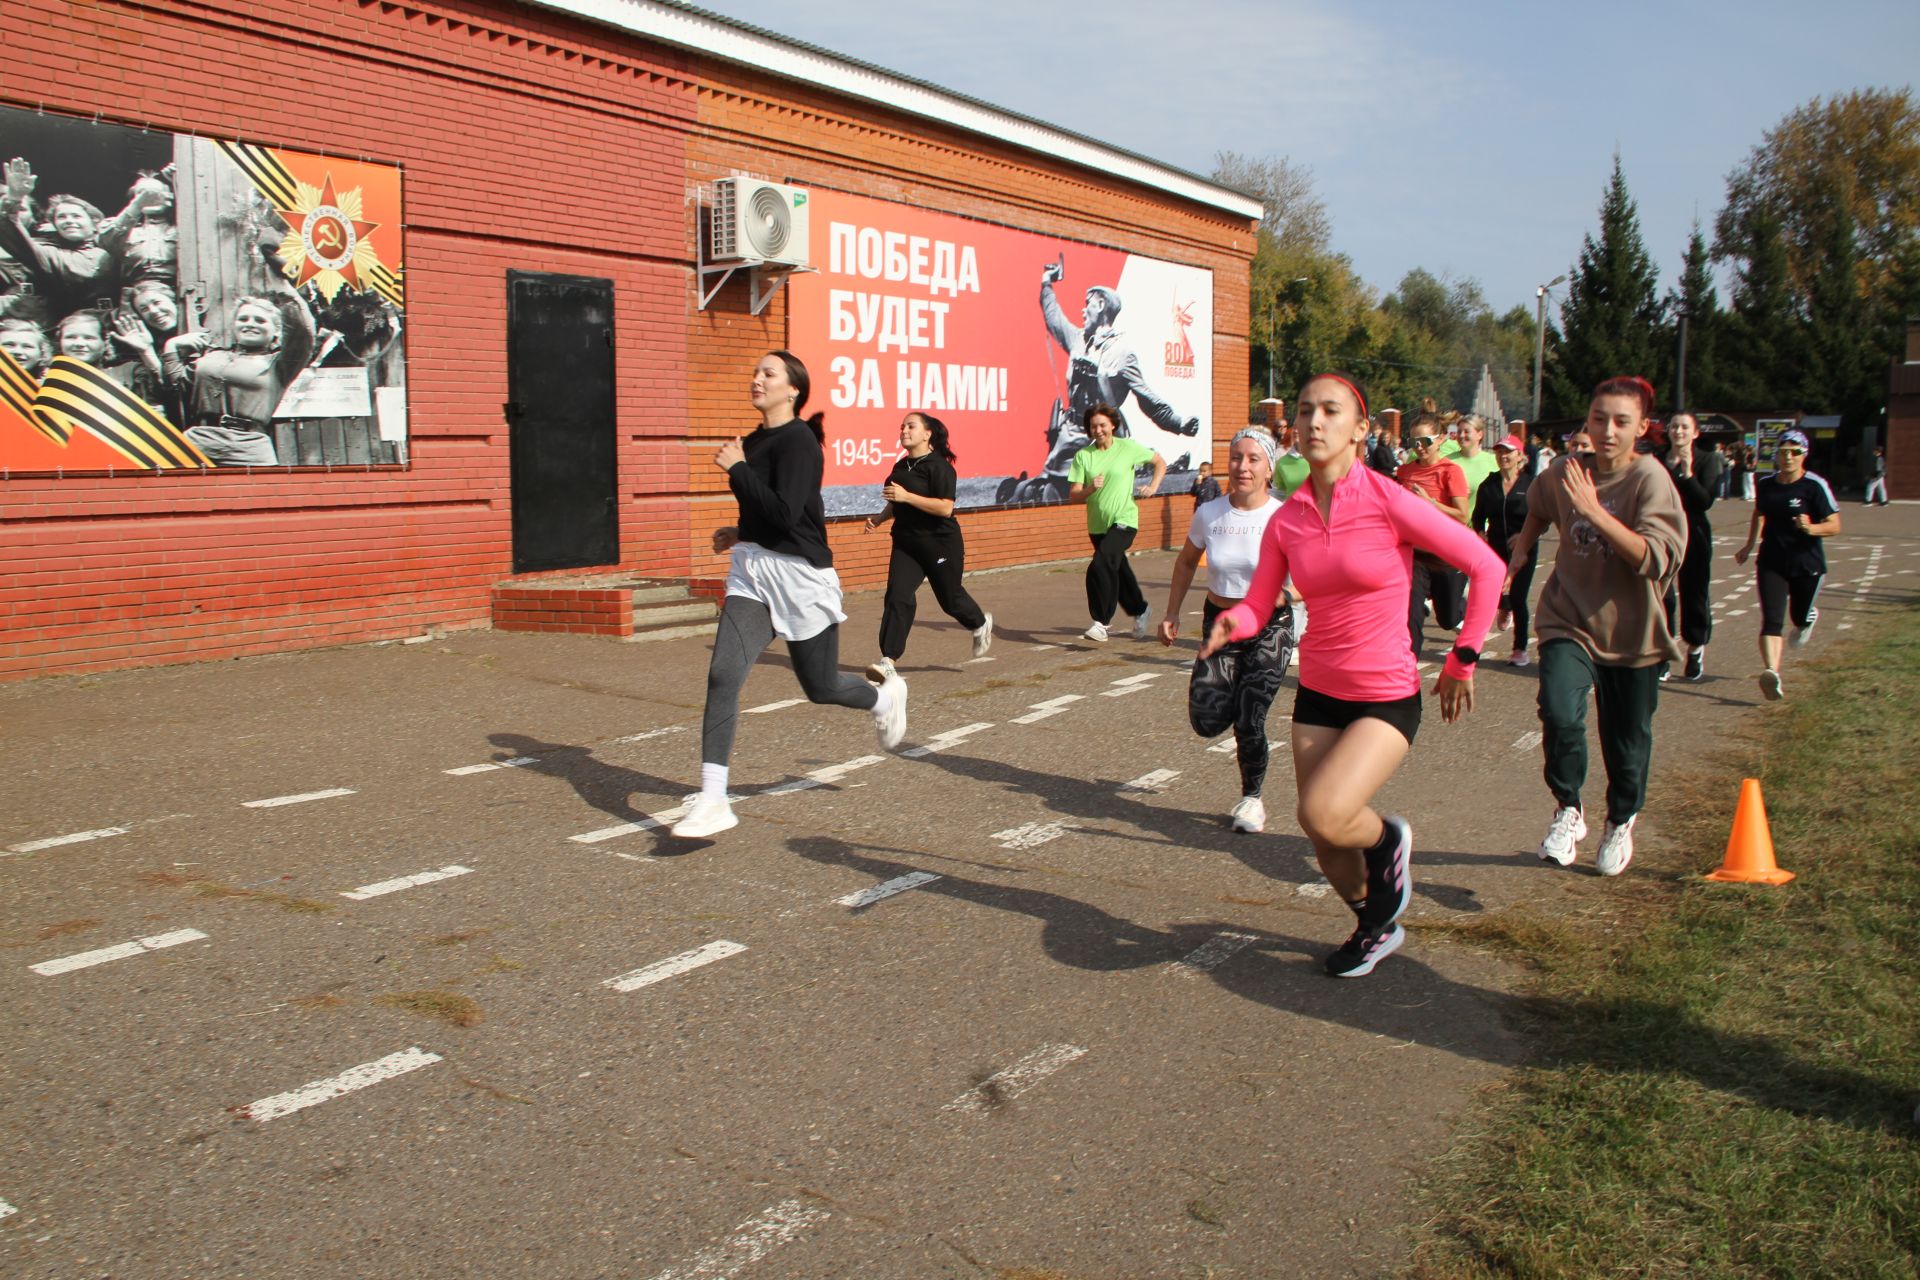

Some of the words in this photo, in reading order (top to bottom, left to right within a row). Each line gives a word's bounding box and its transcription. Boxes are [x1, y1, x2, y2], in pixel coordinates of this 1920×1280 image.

[829, 221, 981, 298] ПОБЕДА
[829, 288, 950, 355] БУДЕТ
[1164, 366, 1196, 379] ПОБЕДА!
[1165, 341, 1181, 364] 80
[830, 356, 885, 409] ЗА
[896, 360, 1008, 412] НАМИ!
